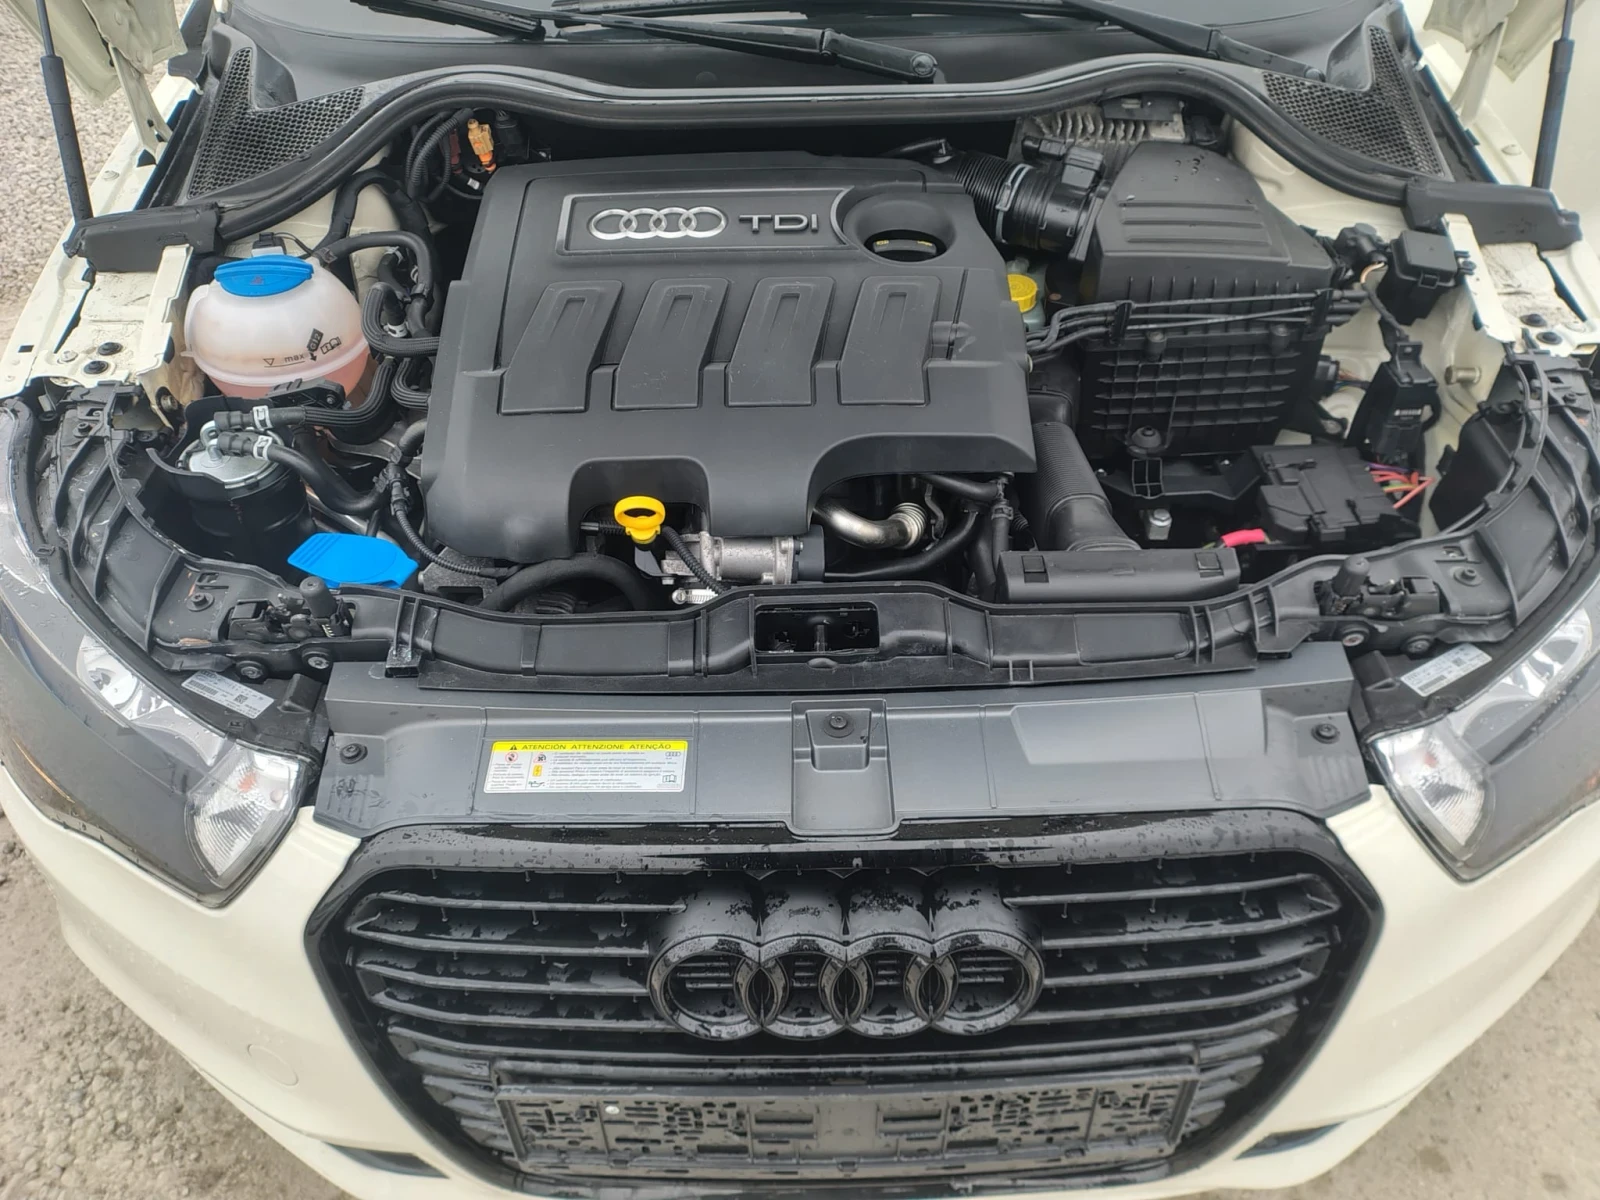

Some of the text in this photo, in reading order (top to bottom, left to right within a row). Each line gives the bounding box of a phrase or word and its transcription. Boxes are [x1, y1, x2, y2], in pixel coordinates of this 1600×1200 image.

[739, 213, 818, 233] TDI
[284, 354, 304, 363] max
[628, 743, 672, 751] ATENÇÃO
